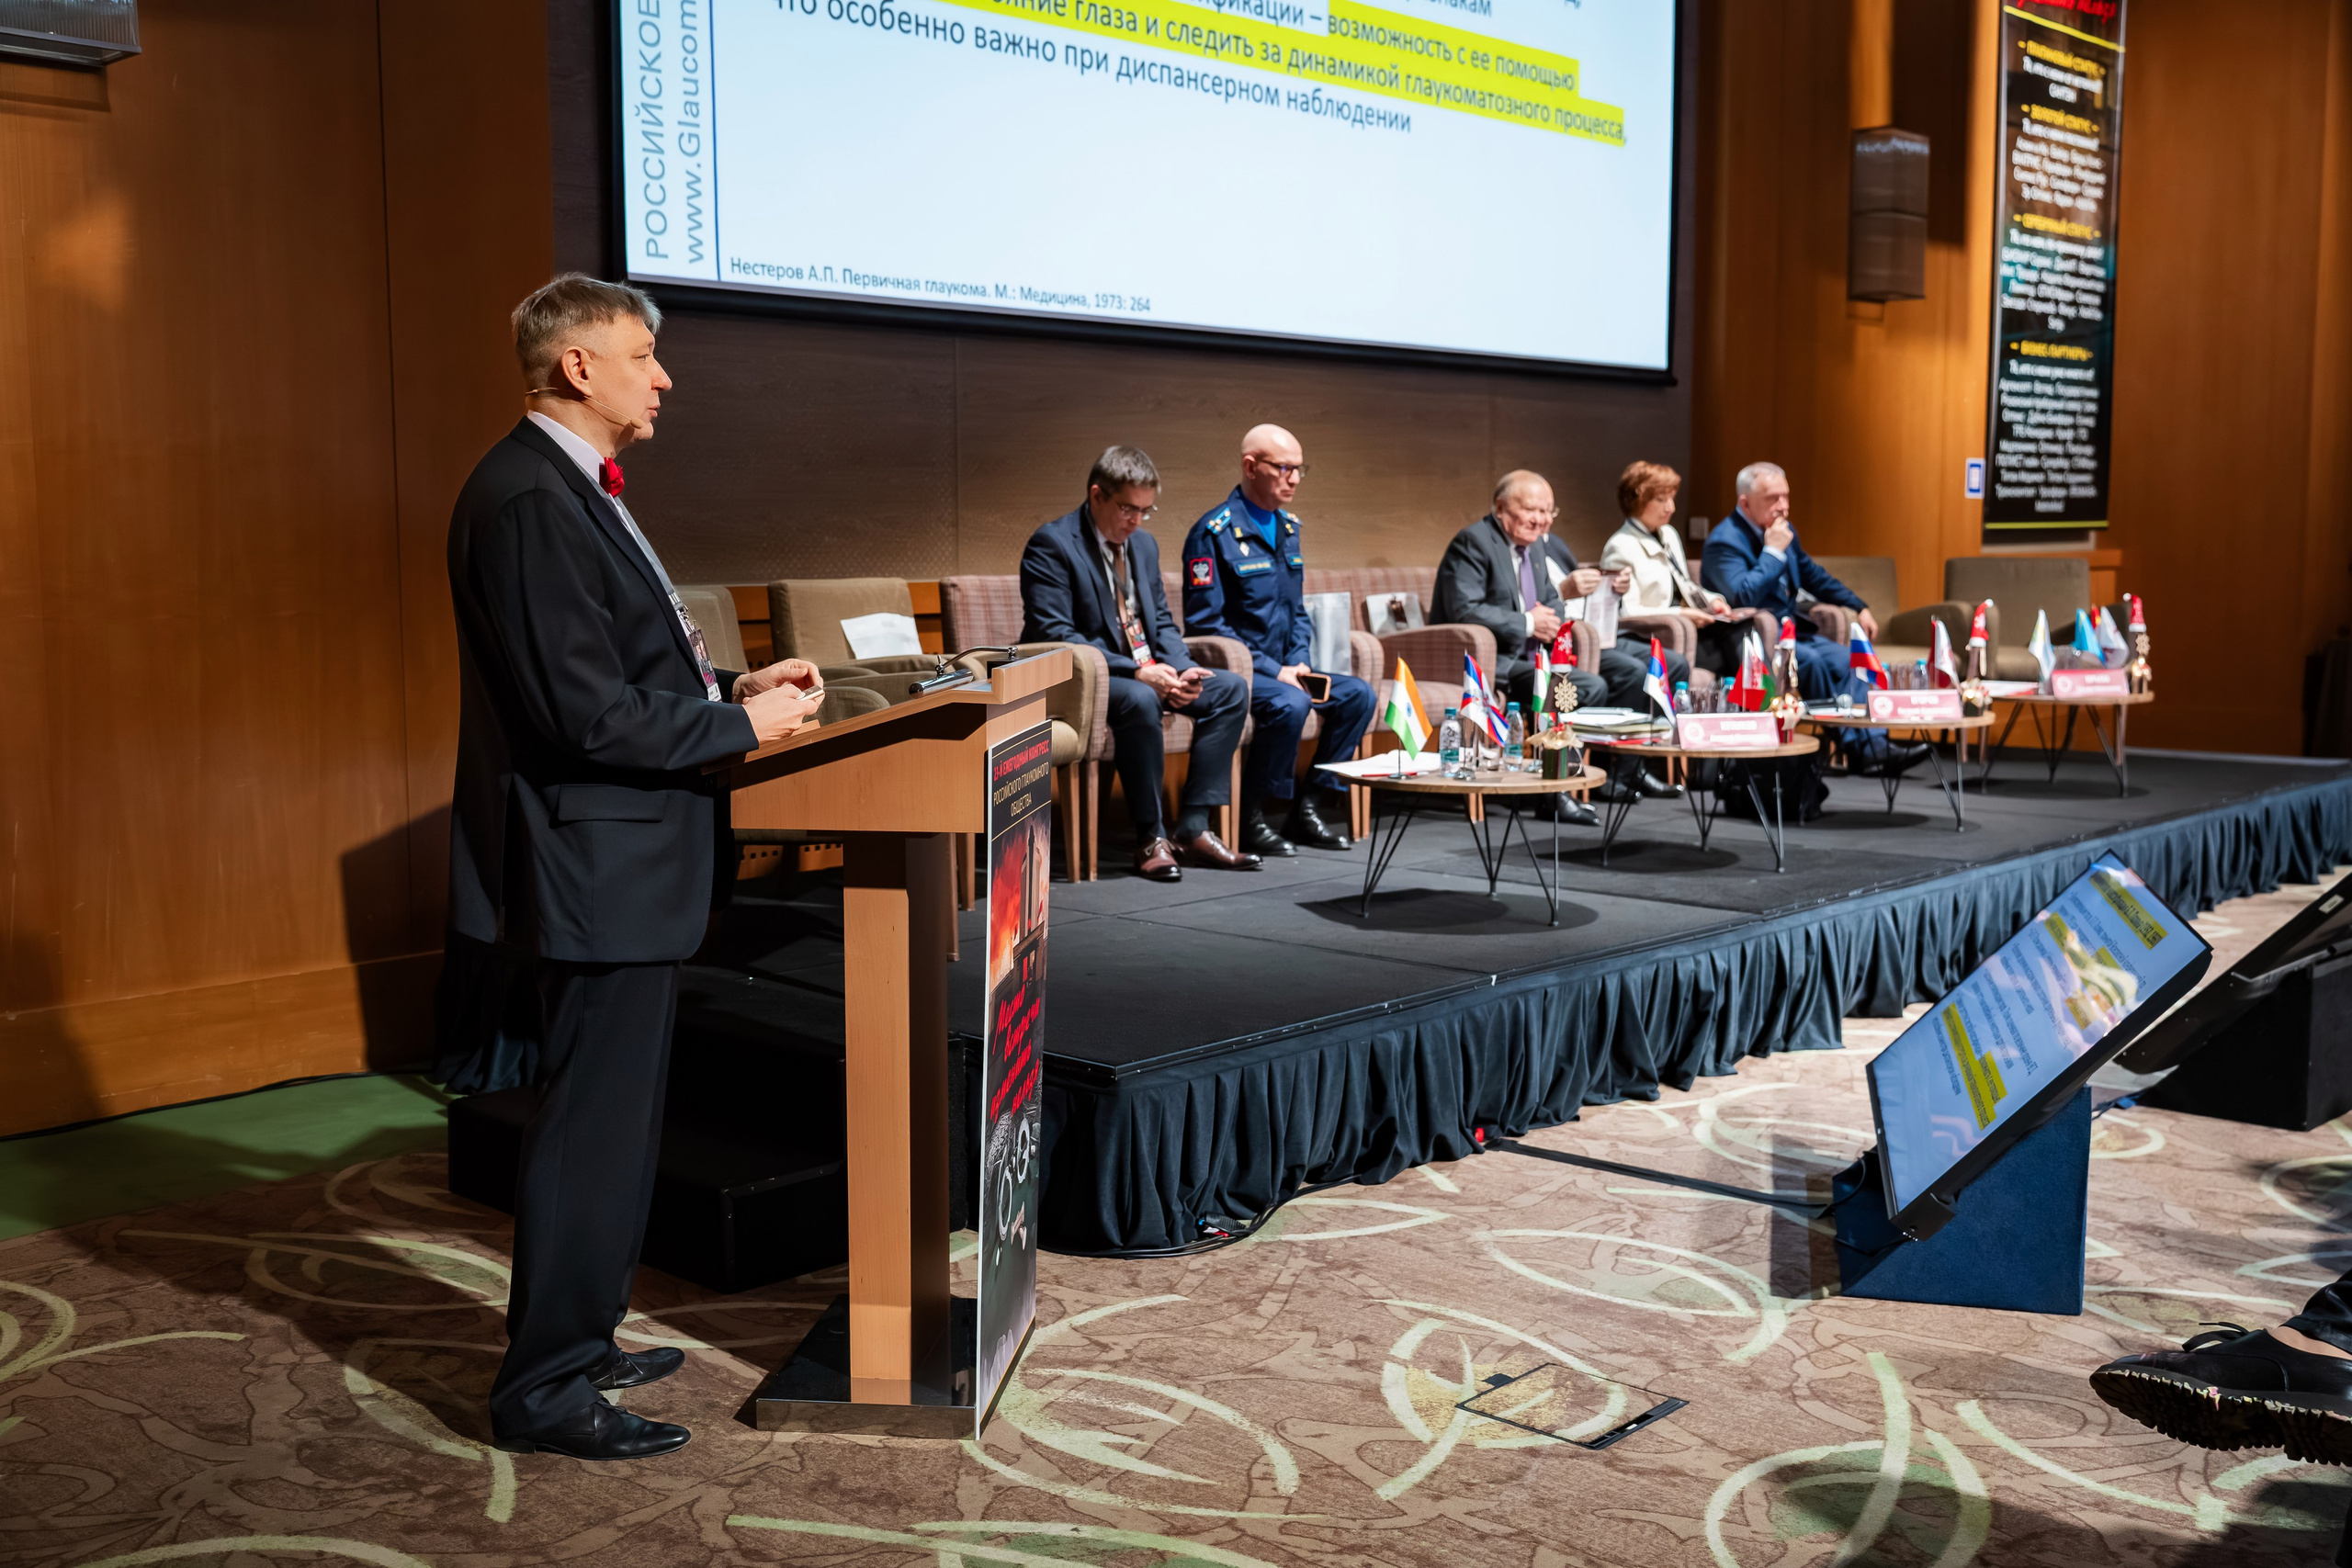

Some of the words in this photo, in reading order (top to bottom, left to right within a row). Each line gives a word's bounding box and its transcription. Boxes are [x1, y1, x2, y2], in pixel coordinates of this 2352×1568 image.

[828, 0, 965, 44] особенно
[975, 27, 1056, 62] важно
[1066, 44, 1108, 75] при
[1116, 56, 1280, 107] диспансерном
[1287, 88, 1411, 133] наблюдении
[1076, 0, 1137, 32] глаза
[1146, 16, 1159, 37] и
[1167, 20, 1254, 57] следить
[1261, 41, 1282, 63] за
[1288, 49, 1400, 89] динамикой
[1406, 73, 1551, 122] глаукоматозного
[1555, 107, 1626, 144] процесса,
[1329, 15, 1453, 62] возможность
[1458, 47, 1466, 64] с
[1471, 51, 1490, 70] ее
[1496, 56, 1575, 91] помощью
[635, 0, 669, 259] РОССИЙСКОЕ
[677, 0, 704, 264] www.Glaucom
[730, 257, 804, 281] Нестеров
[808, 265, 838, 283] А.П.
[842, 268, 920, 290] Первичная
[925, 279, 990, 298] глаукома.
[995, 283, 1015, 299] М.:
[1020, 286, 1091, 309] Медицина,
[1095, 293, 1126, 310] 1973:
[1130, 296, 1150, 312] 264
[993, 776, 1022, 807] РОССИЙСКОГО
[1011, 792, 1033, 818] ОБЩЕСТВА
